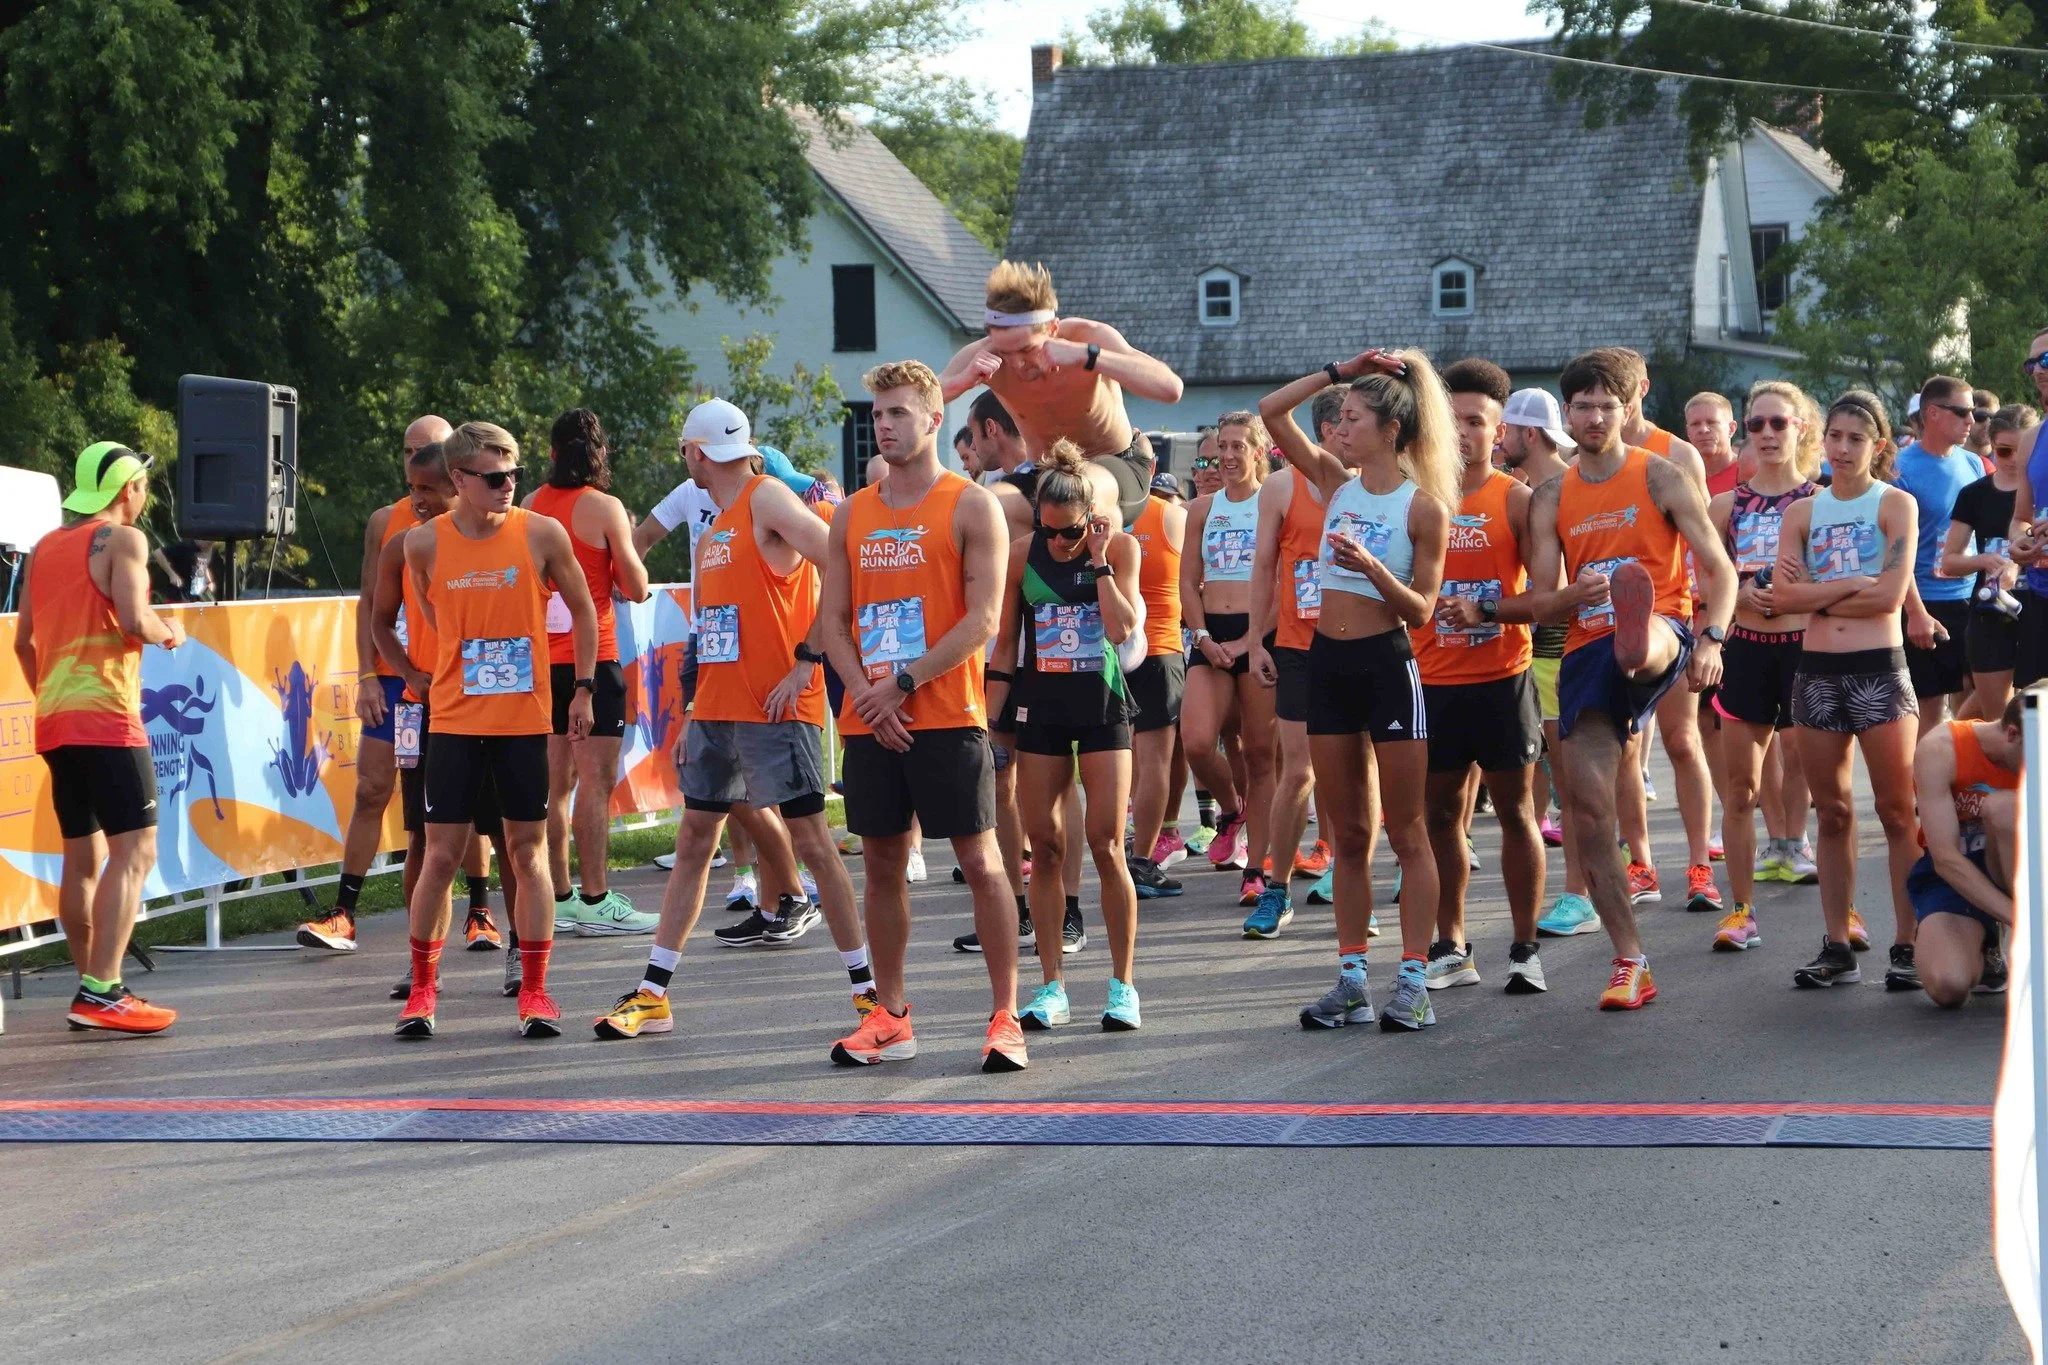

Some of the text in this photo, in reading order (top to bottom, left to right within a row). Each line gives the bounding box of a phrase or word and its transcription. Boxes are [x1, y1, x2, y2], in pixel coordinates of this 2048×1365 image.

[1569, 521, 1593, 537] NARK
[860, 541, 907, 556] NARK
[1214, 548, 1257, 570] 173
[860, 553, 919, 569] RUNNING
[1829, 547, 1861, 573] 11
[446, 577, 473, 590] NARK
[1299, 581, 1320, 603] 2
[1056, 605, 1072, 615] RUN
[701, 631, 735, 657] 137
[880, 628, 901, 655] 4
[1059, 628, 1080, 653] 9
[1735, 628, 1788, 644] ARMOUR
[477, 663, 519, 690] 63
[154, 758, 186, 779] RENGTH
